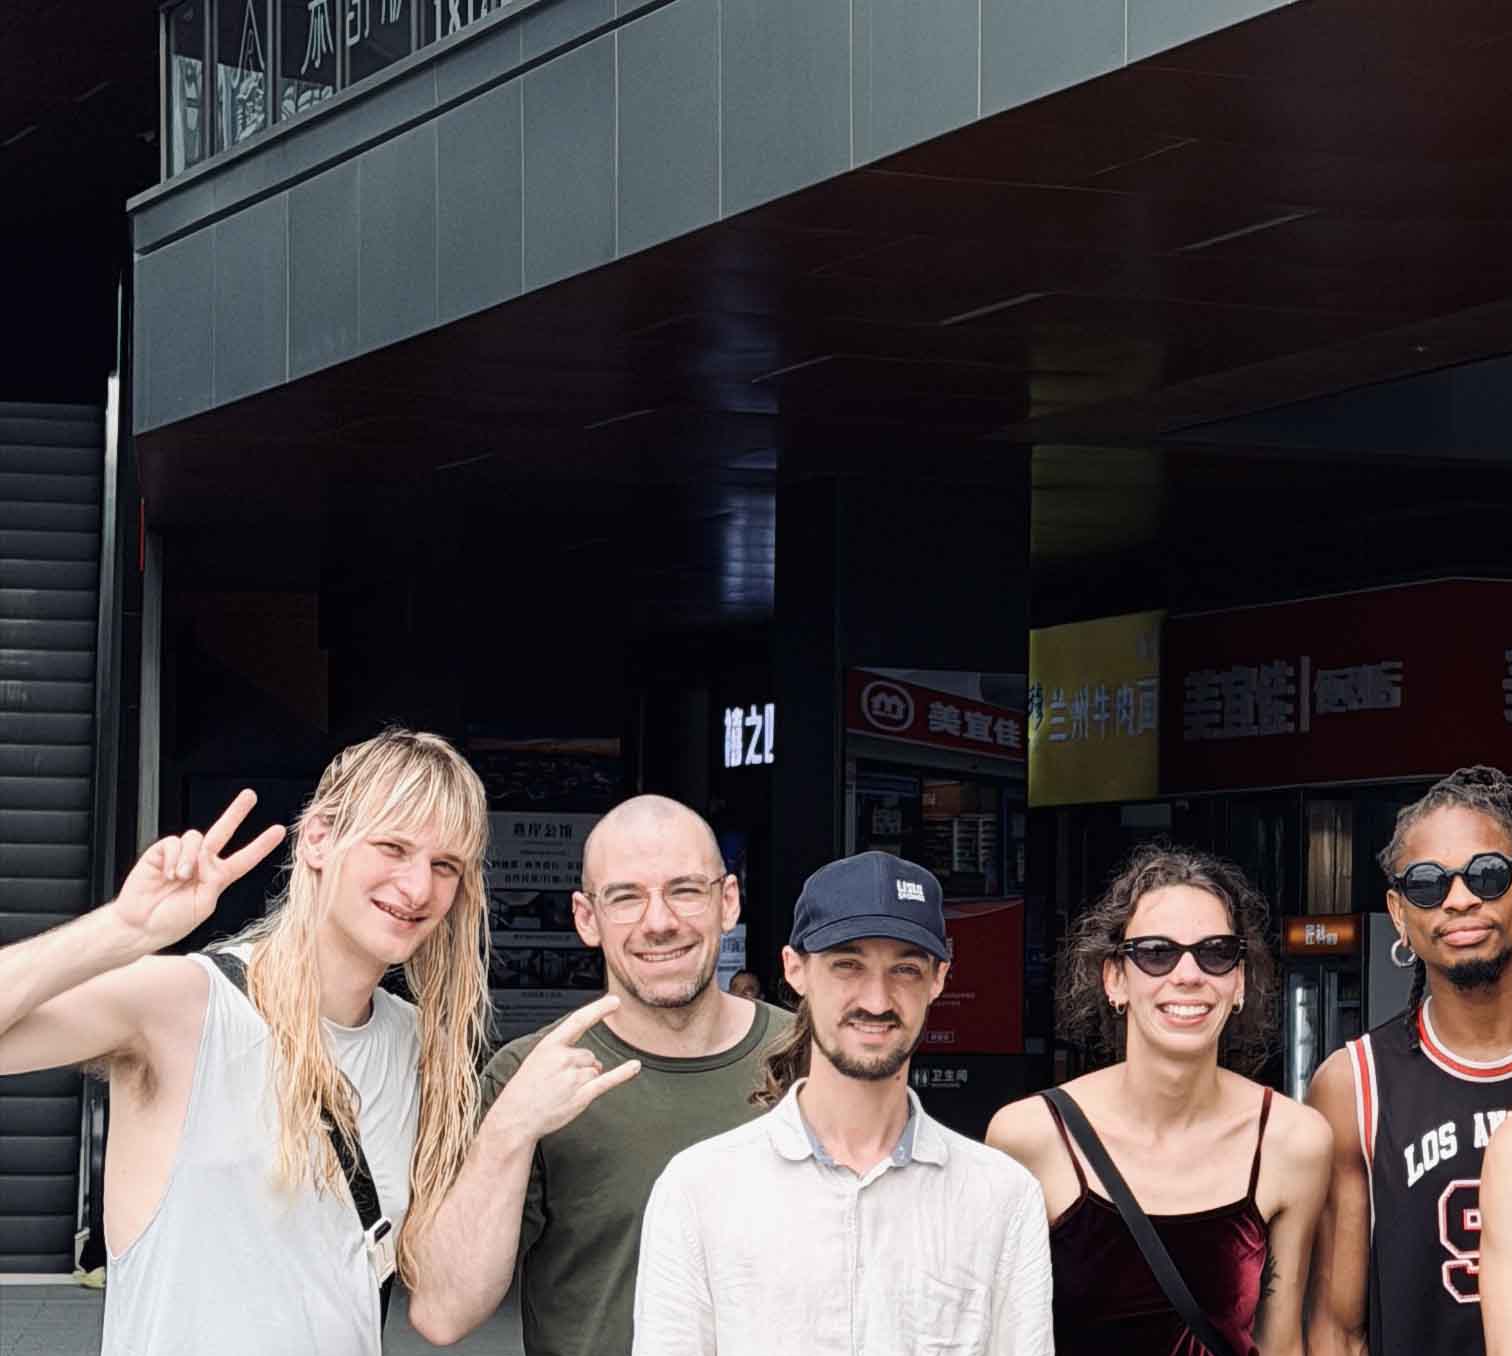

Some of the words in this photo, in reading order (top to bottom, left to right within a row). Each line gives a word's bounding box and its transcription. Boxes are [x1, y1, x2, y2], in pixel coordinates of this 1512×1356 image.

[929, 701, 1022, 749] 美宜佳
[931, 1069, 968, 1083] 卫生间
[1404, 1121, 1458, 1188] LOS
